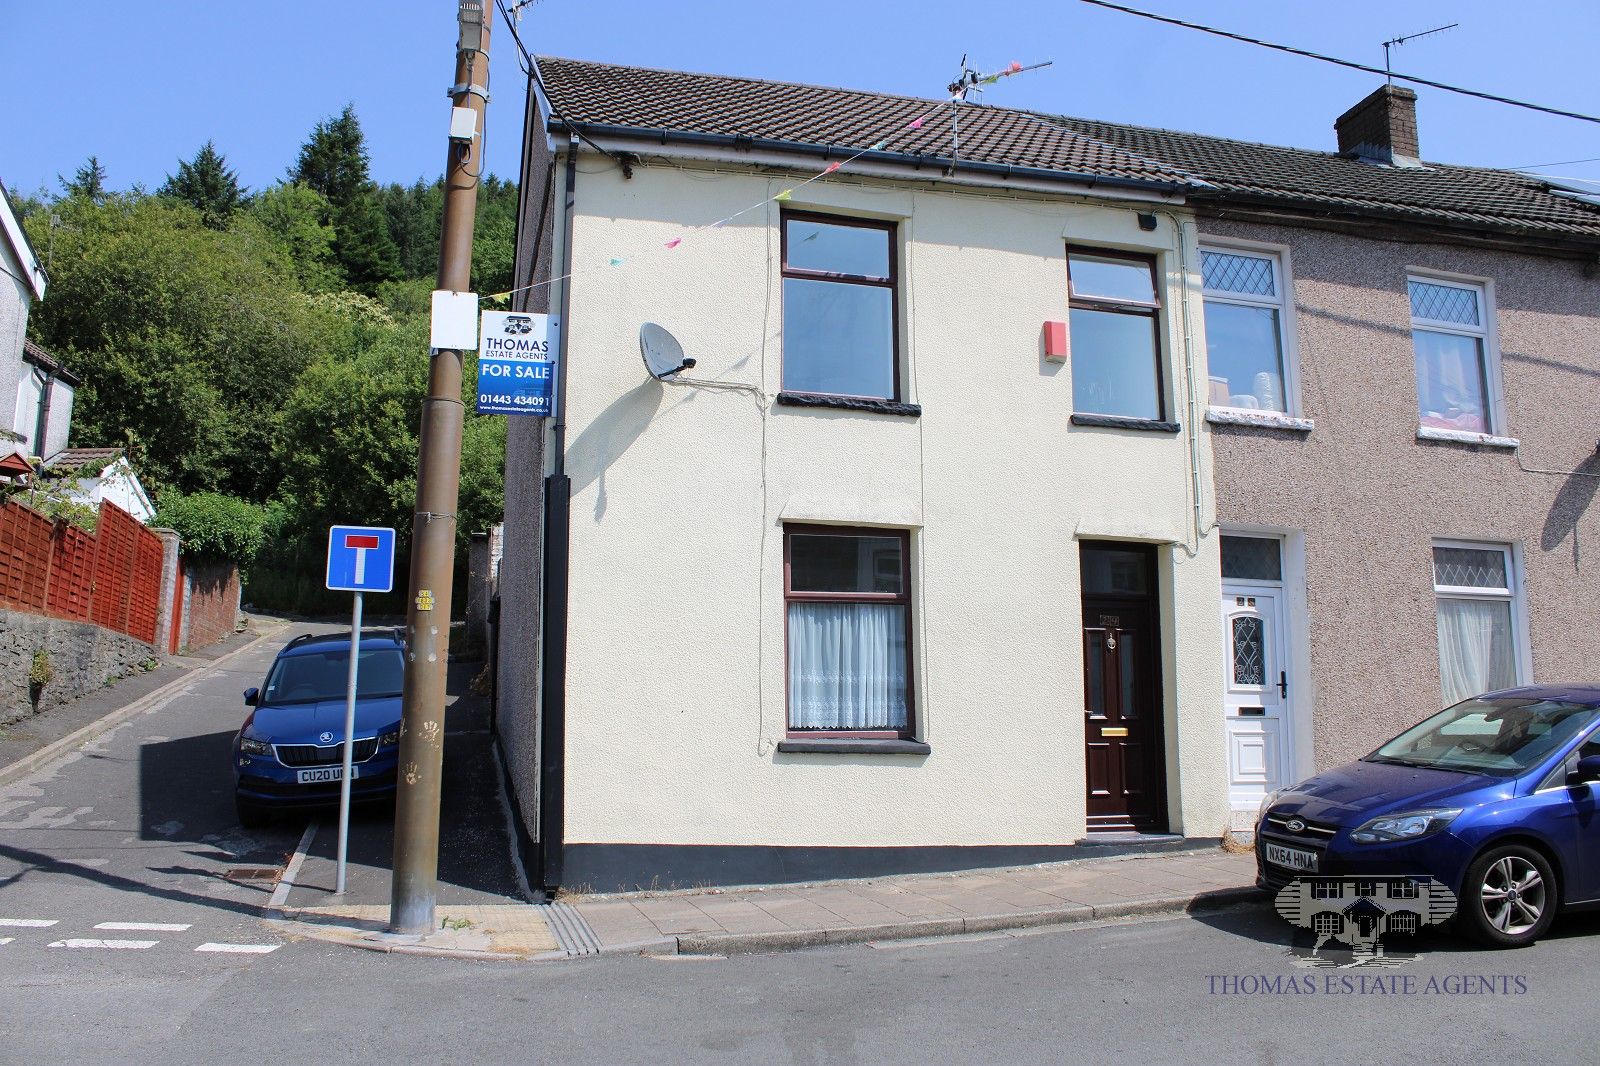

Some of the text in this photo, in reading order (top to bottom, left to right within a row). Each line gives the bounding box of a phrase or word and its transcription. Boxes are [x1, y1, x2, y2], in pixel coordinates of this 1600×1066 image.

[486, 337, 549, 352] THOMAS
[485, 350, 548, 360] ESTATE AGENTS
[482, 363, 549, 379] FOR SALE
[480, 394, 549, 406] 01443 434091
[302, 769, 331, 782] CU20
[1269, 846, 1314, 869] NX64 HNA
